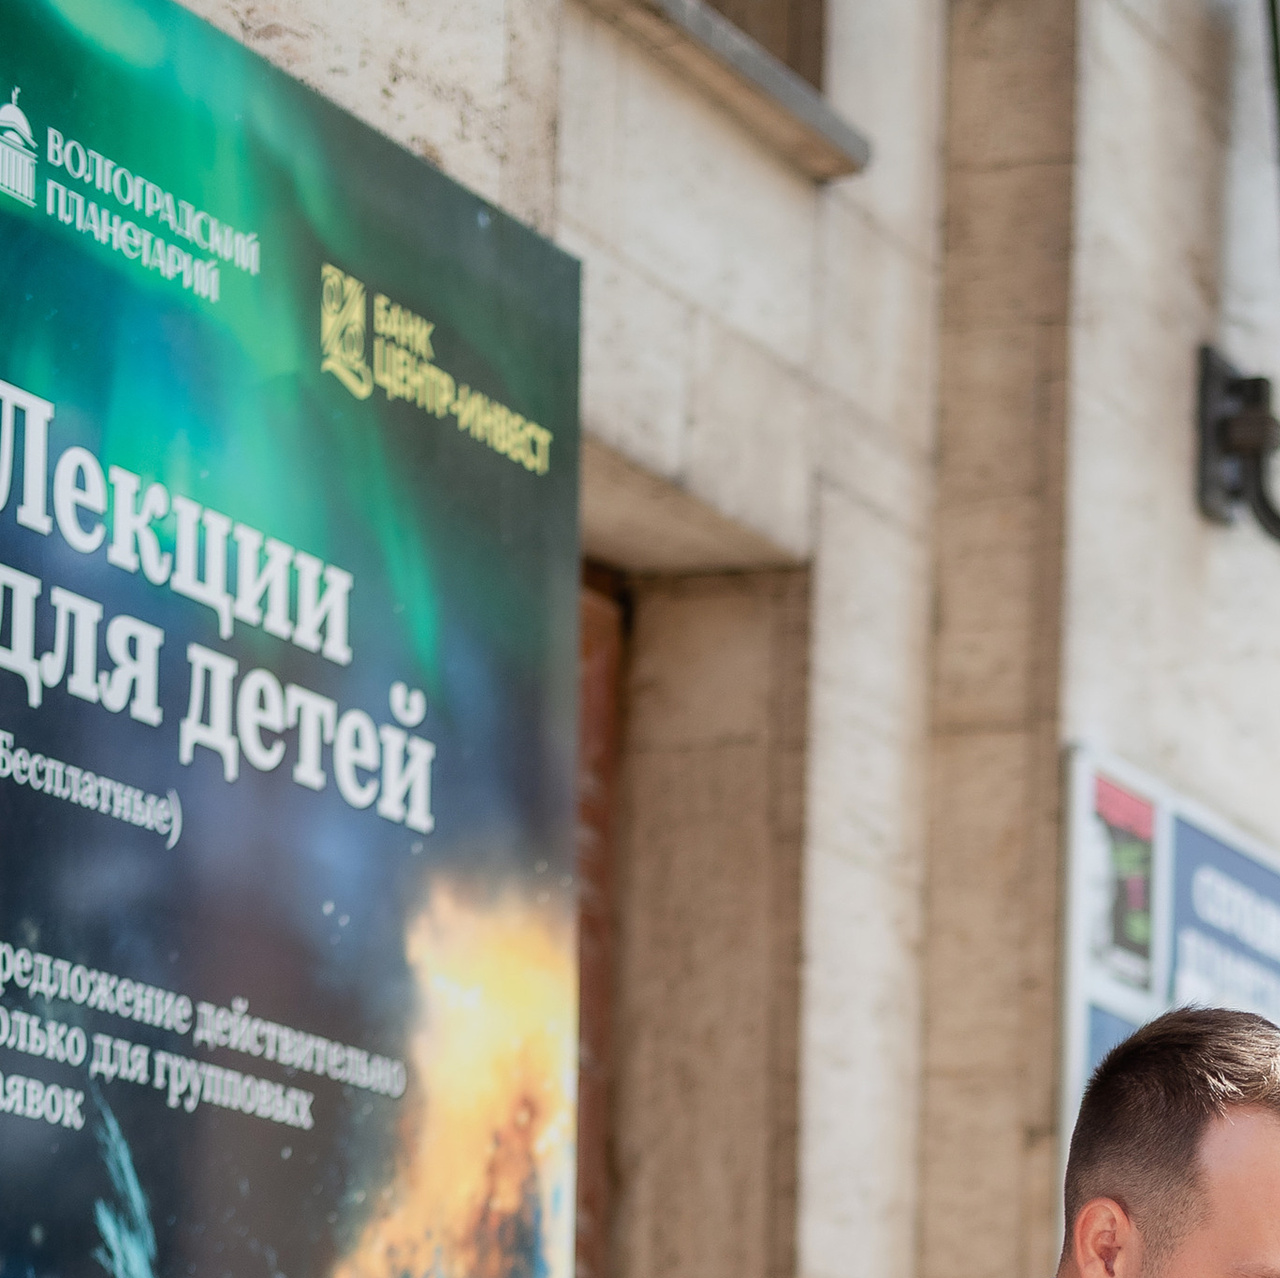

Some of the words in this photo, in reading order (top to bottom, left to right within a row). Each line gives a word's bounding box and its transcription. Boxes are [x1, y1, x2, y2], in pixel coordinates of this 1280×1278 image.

[46, 126, 261, 277] ВОЛГОГРАДСКИЙ
[46, 178, 220, 304] ПЛАНЕТАРИЙ
[0, 378, 354, 666] Лекции
[0, 562, 165, 727] для
[179, 643, 437, 834] детей
[0, 1069, 86, 1132] явок
[89, 1032, 151, 1085] для
[152, 1050, 316, 1131] групповых
[193, 996, 408, 1099] действительно
